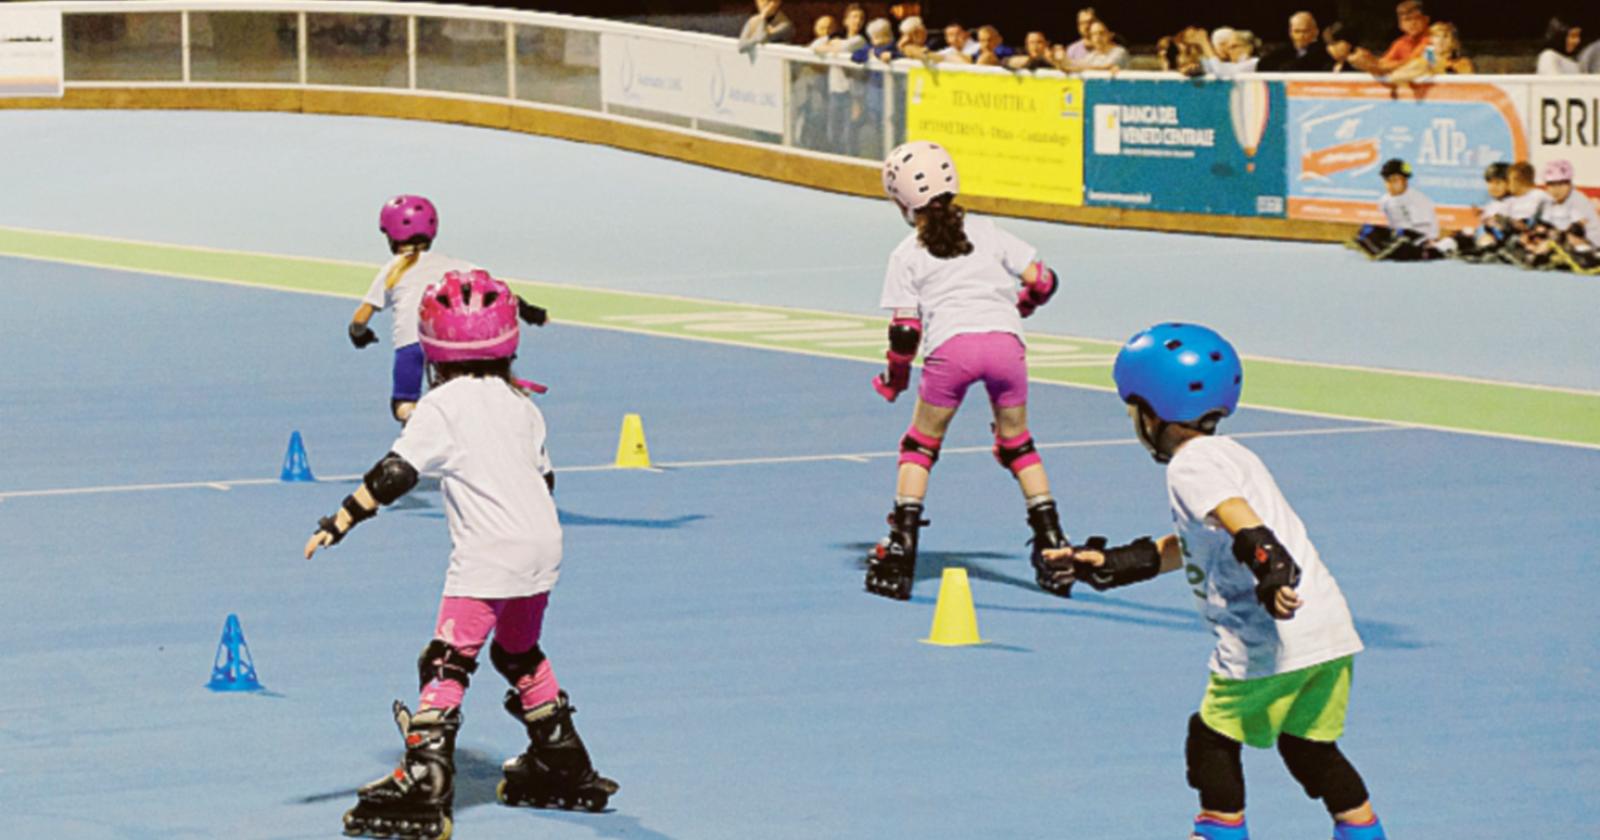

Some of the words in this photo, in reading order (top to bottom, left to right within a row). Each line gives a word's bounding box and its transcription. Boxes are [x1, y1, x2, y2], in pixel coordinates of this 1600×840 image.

[993, 93, 1037, 113] OTTICA
[1122, 104, 1158, 124] BANCA
[1158, 106, 1179, 125] DEL
[1122, 126, 1162, 145] VENETO
[1163, 128, 1215, 147] CENTRALE
[1415, 117, 1467, 166] ATP
